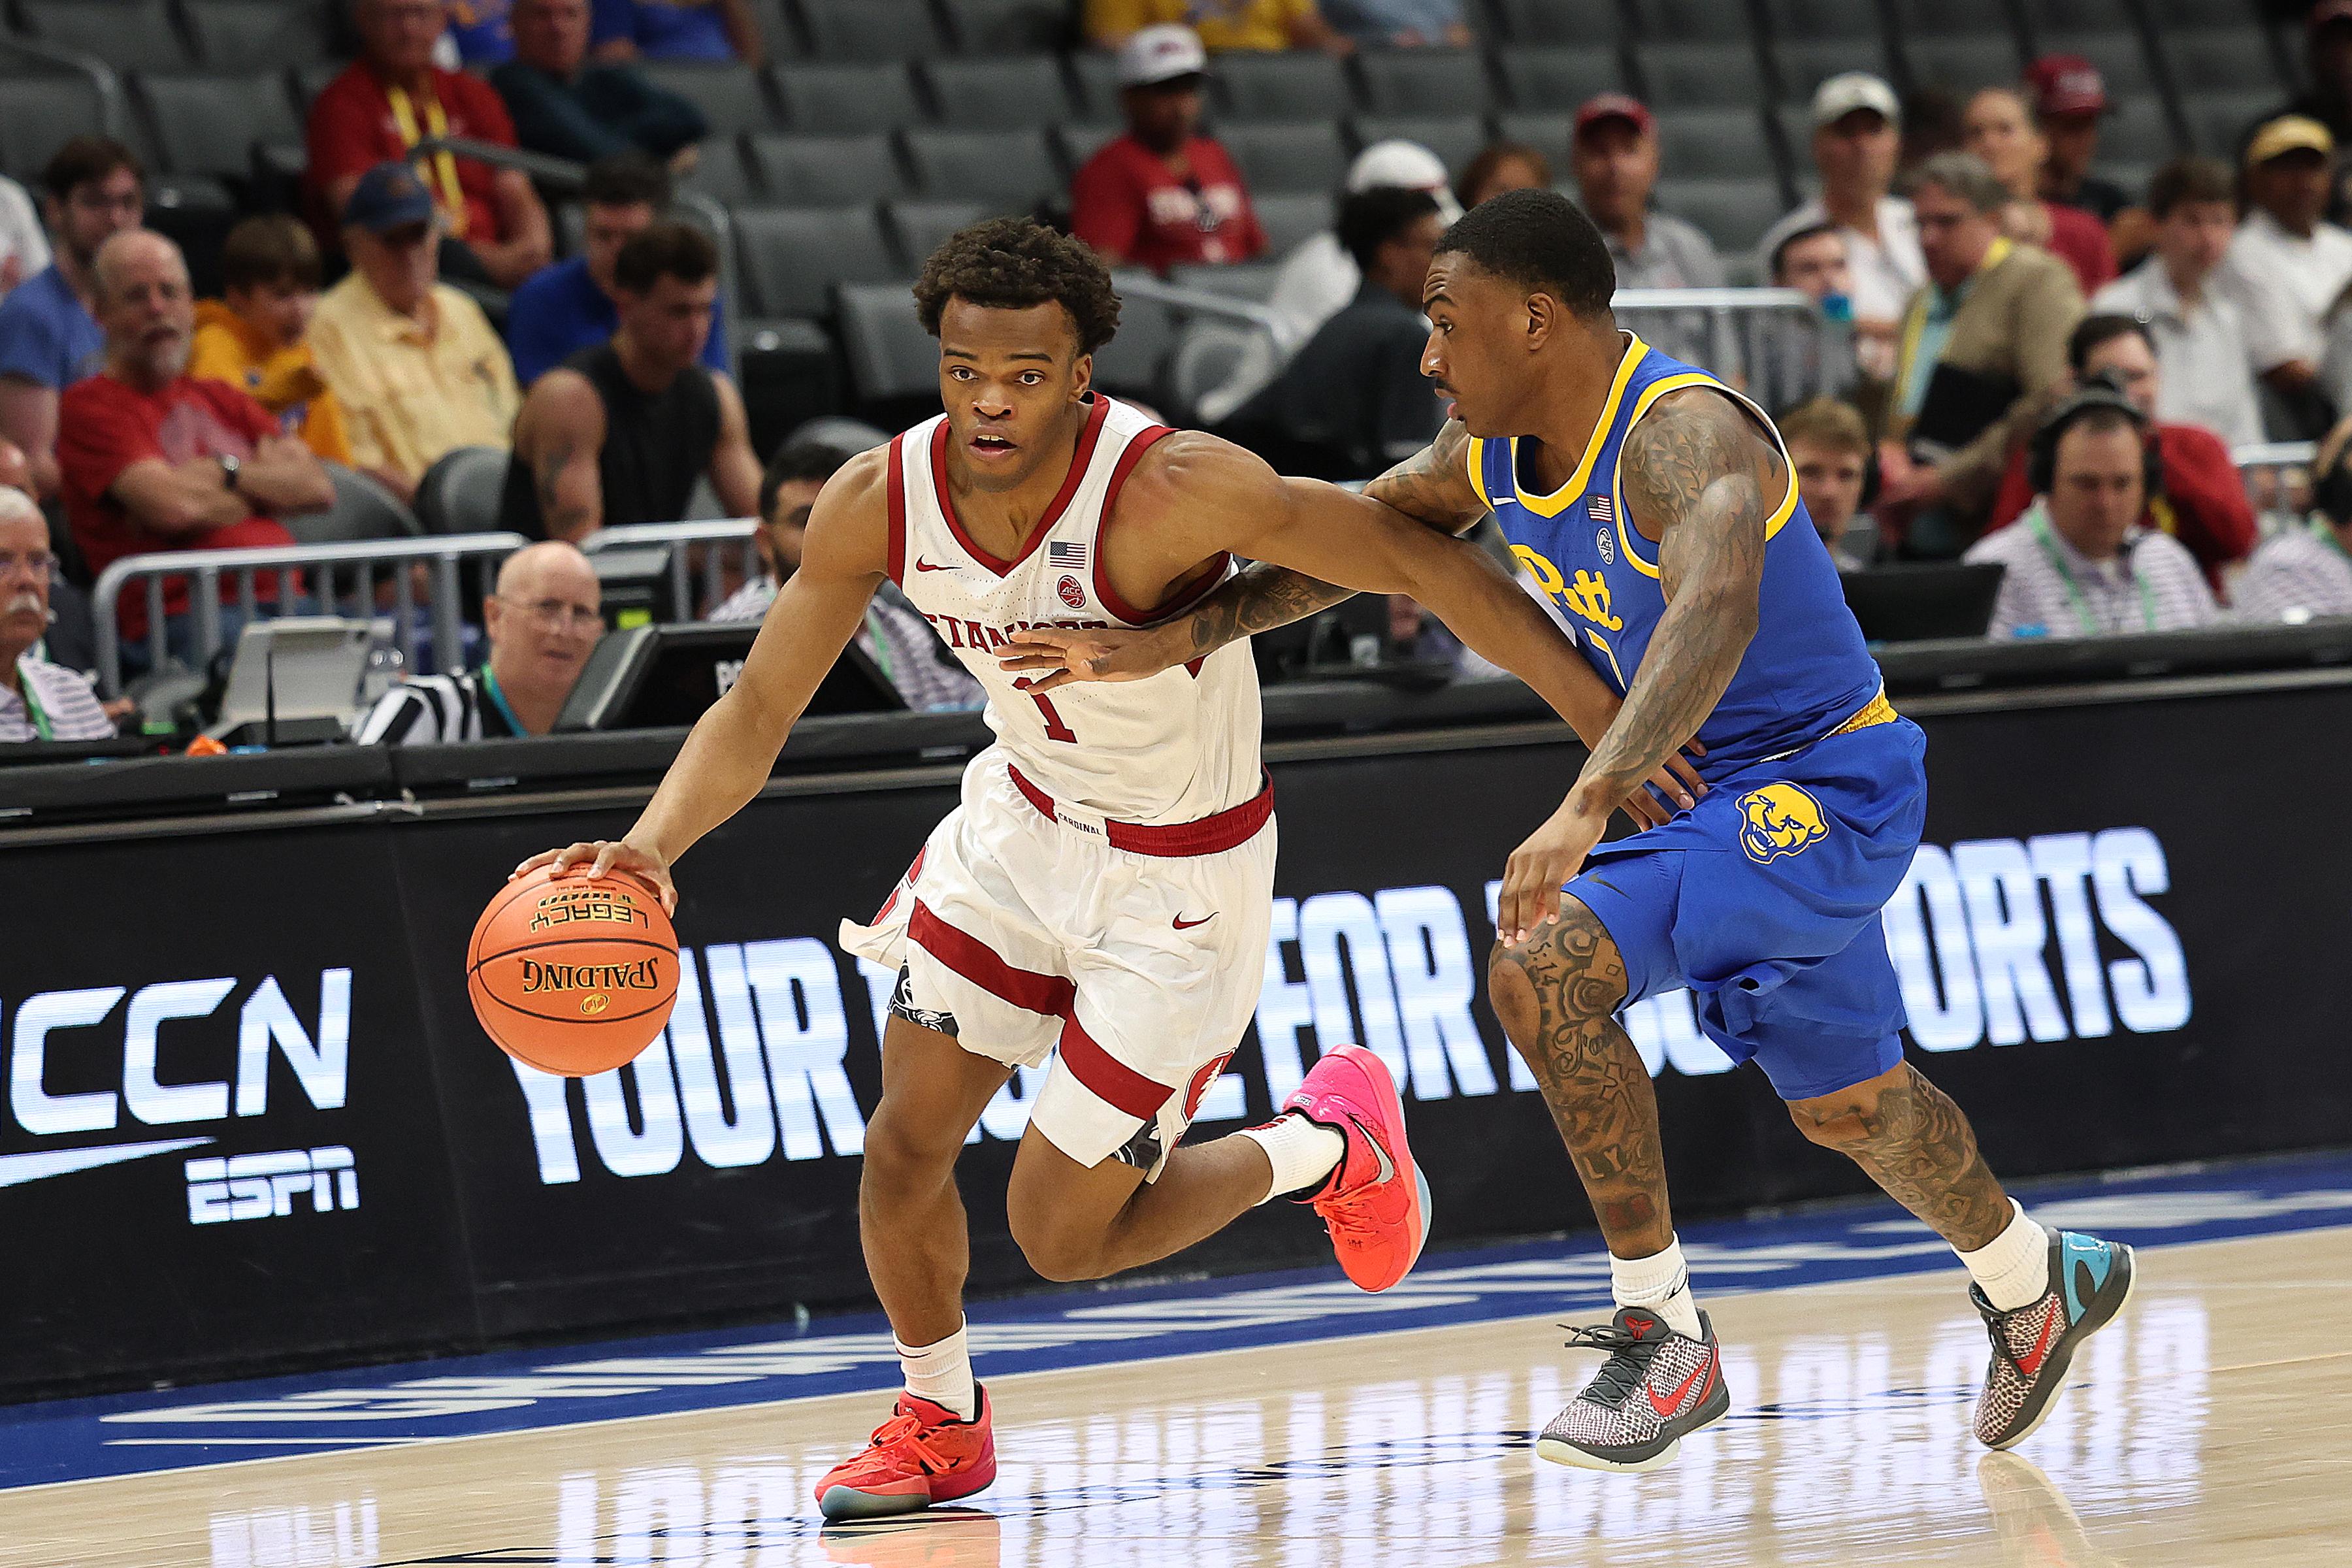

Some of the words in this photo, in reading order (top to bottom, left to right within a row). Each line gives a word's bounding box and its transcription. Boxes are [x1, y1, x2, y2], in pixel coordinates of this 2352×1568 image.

[1061, 587, 1081, 595] ACC
[1509, 544, 1623, 632] Pitt
[1012, 676, 1079, 744] 1
[1058, 812, 1102, 836] CARDINAL
[530, 903, 649, 933] LEGACY
[523, 956, 659, 994] SPALDING
[1256, 885, 1497, 1113] FOR
[1882, 826, 2192, 1053] ORTS
[0, 967, 353, 1135] CCN
[185, 1145, 359, 1225] ESPN
